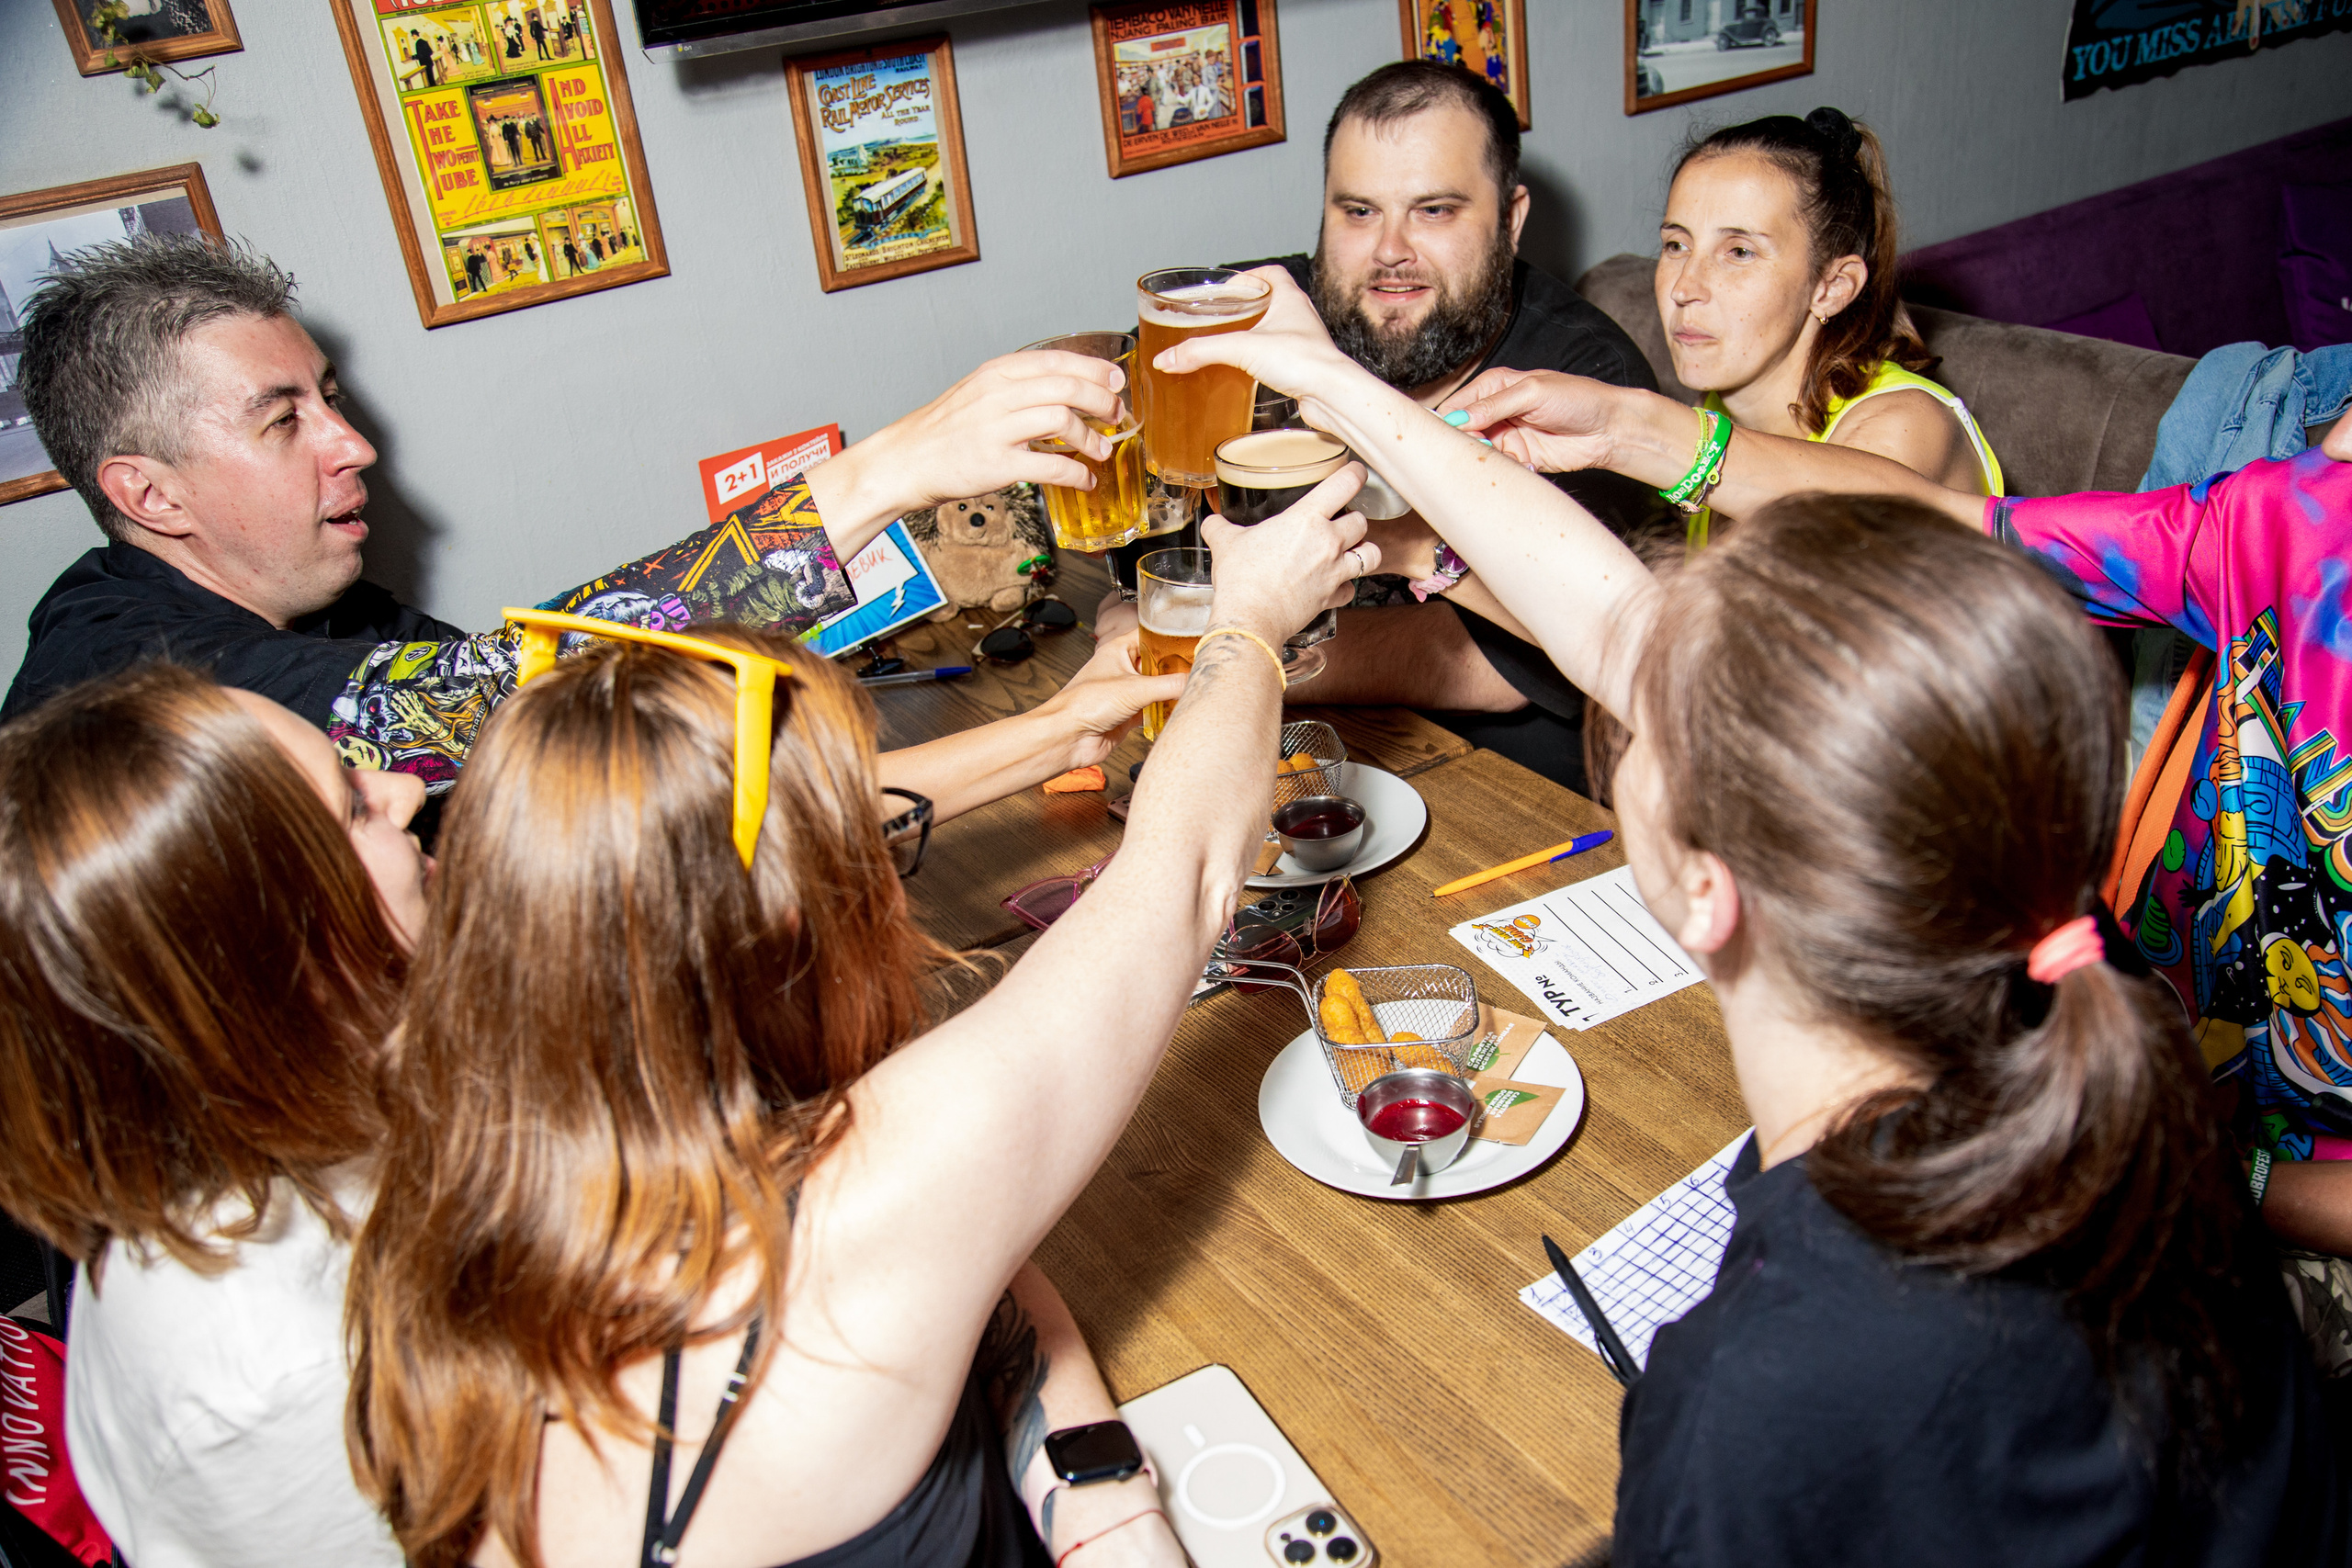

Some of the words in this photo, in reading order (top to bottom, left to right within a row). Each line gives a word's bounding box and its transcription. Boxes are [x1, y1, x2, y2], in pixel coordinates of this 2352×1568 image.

[1157, 17, 1196, 32] PALING
[2072, 36, 2134, 81] YOU
[2133, 18, 2203, 66] MISS
[818, 84, 851, 107] COAST
[849, 73, 876, 101] LINE
[820, 107, 851, 134] RAIL
[849, 93, 887, 128] MOTOR
[884, 77, 931, 111] SERVICES
[725, 463, 758, 493] 2+1
[770, 469, 779, 479] И
[781, 445, 827, 471] ПОЛУЧИ
[1544, 990, 1581, 1017] ТУР
[1467, 1031, 1494, 1066] САЛФЕТКА
[1473, 1034, 1498, 1069] ВЛАЖНАЯ
[1478, 1022, 1515, 1071] ОСВЕЖАЮЩАЯ
[1689, 1175, 1700, 1187] 6
[1659, 1193, 1671, 1209] 5
[1623, 1222, 1635, 1235] 4
[1589, 1247, 1602, 1260] 3
